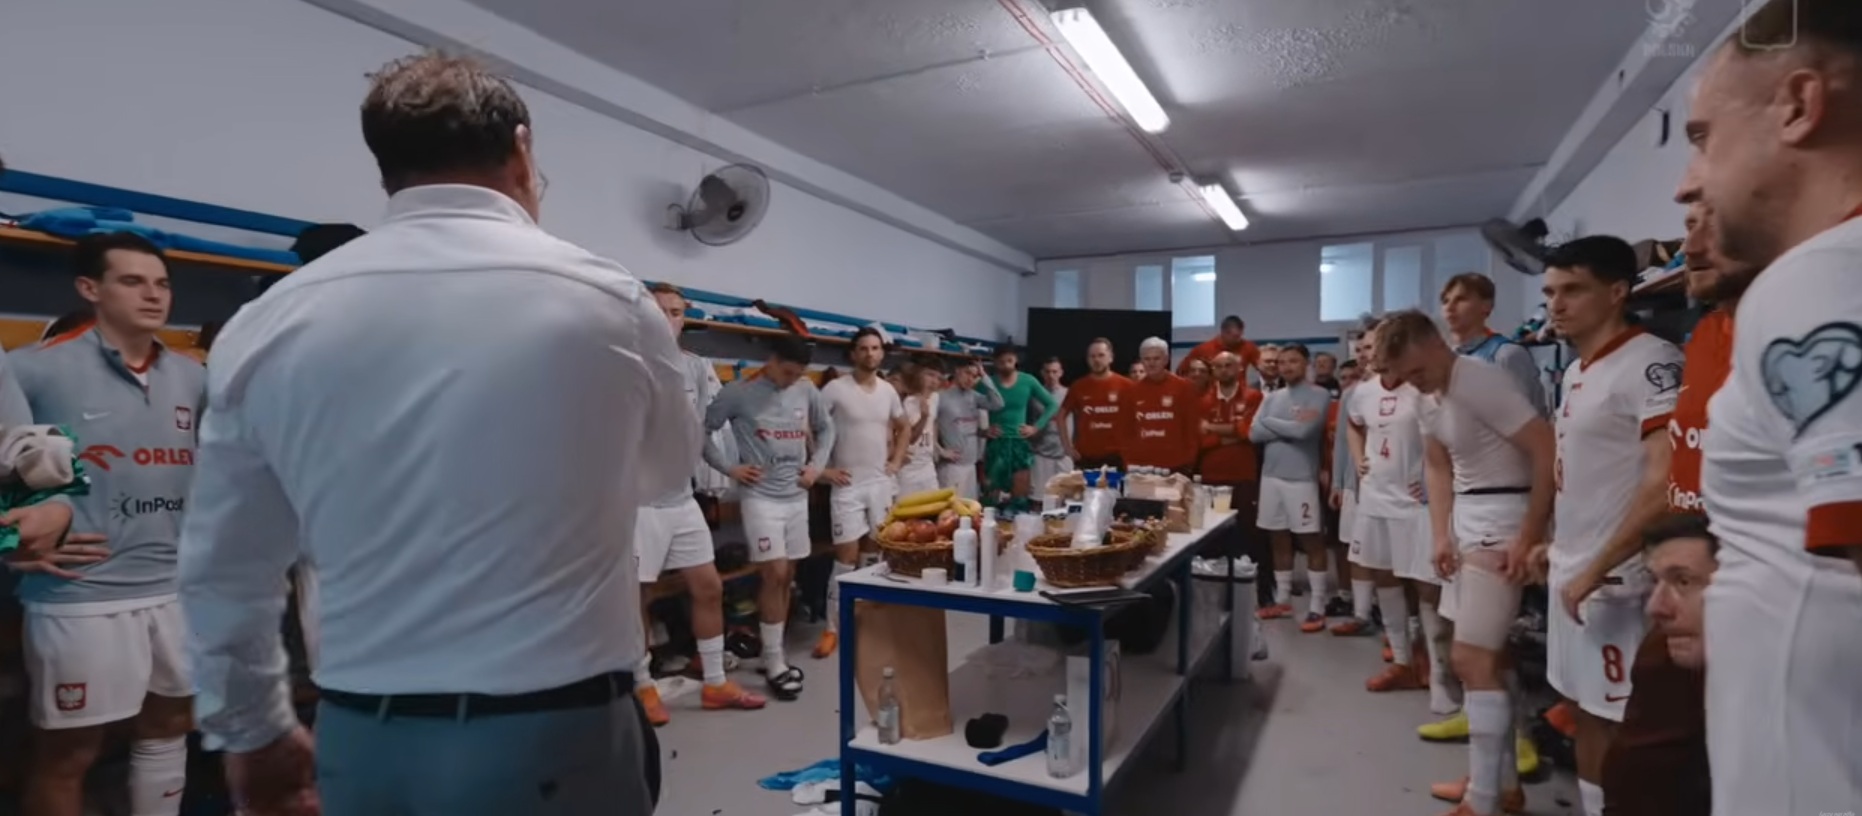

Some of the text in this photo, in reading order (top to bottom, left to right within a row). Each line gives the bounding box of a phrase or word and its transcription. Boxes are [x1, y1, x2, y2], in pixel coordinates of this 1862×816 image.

[1380, 437, 1390, 459] 4
[1301, 502, 1312, 519] 2
[1602, 643, 1624, 684] 8
